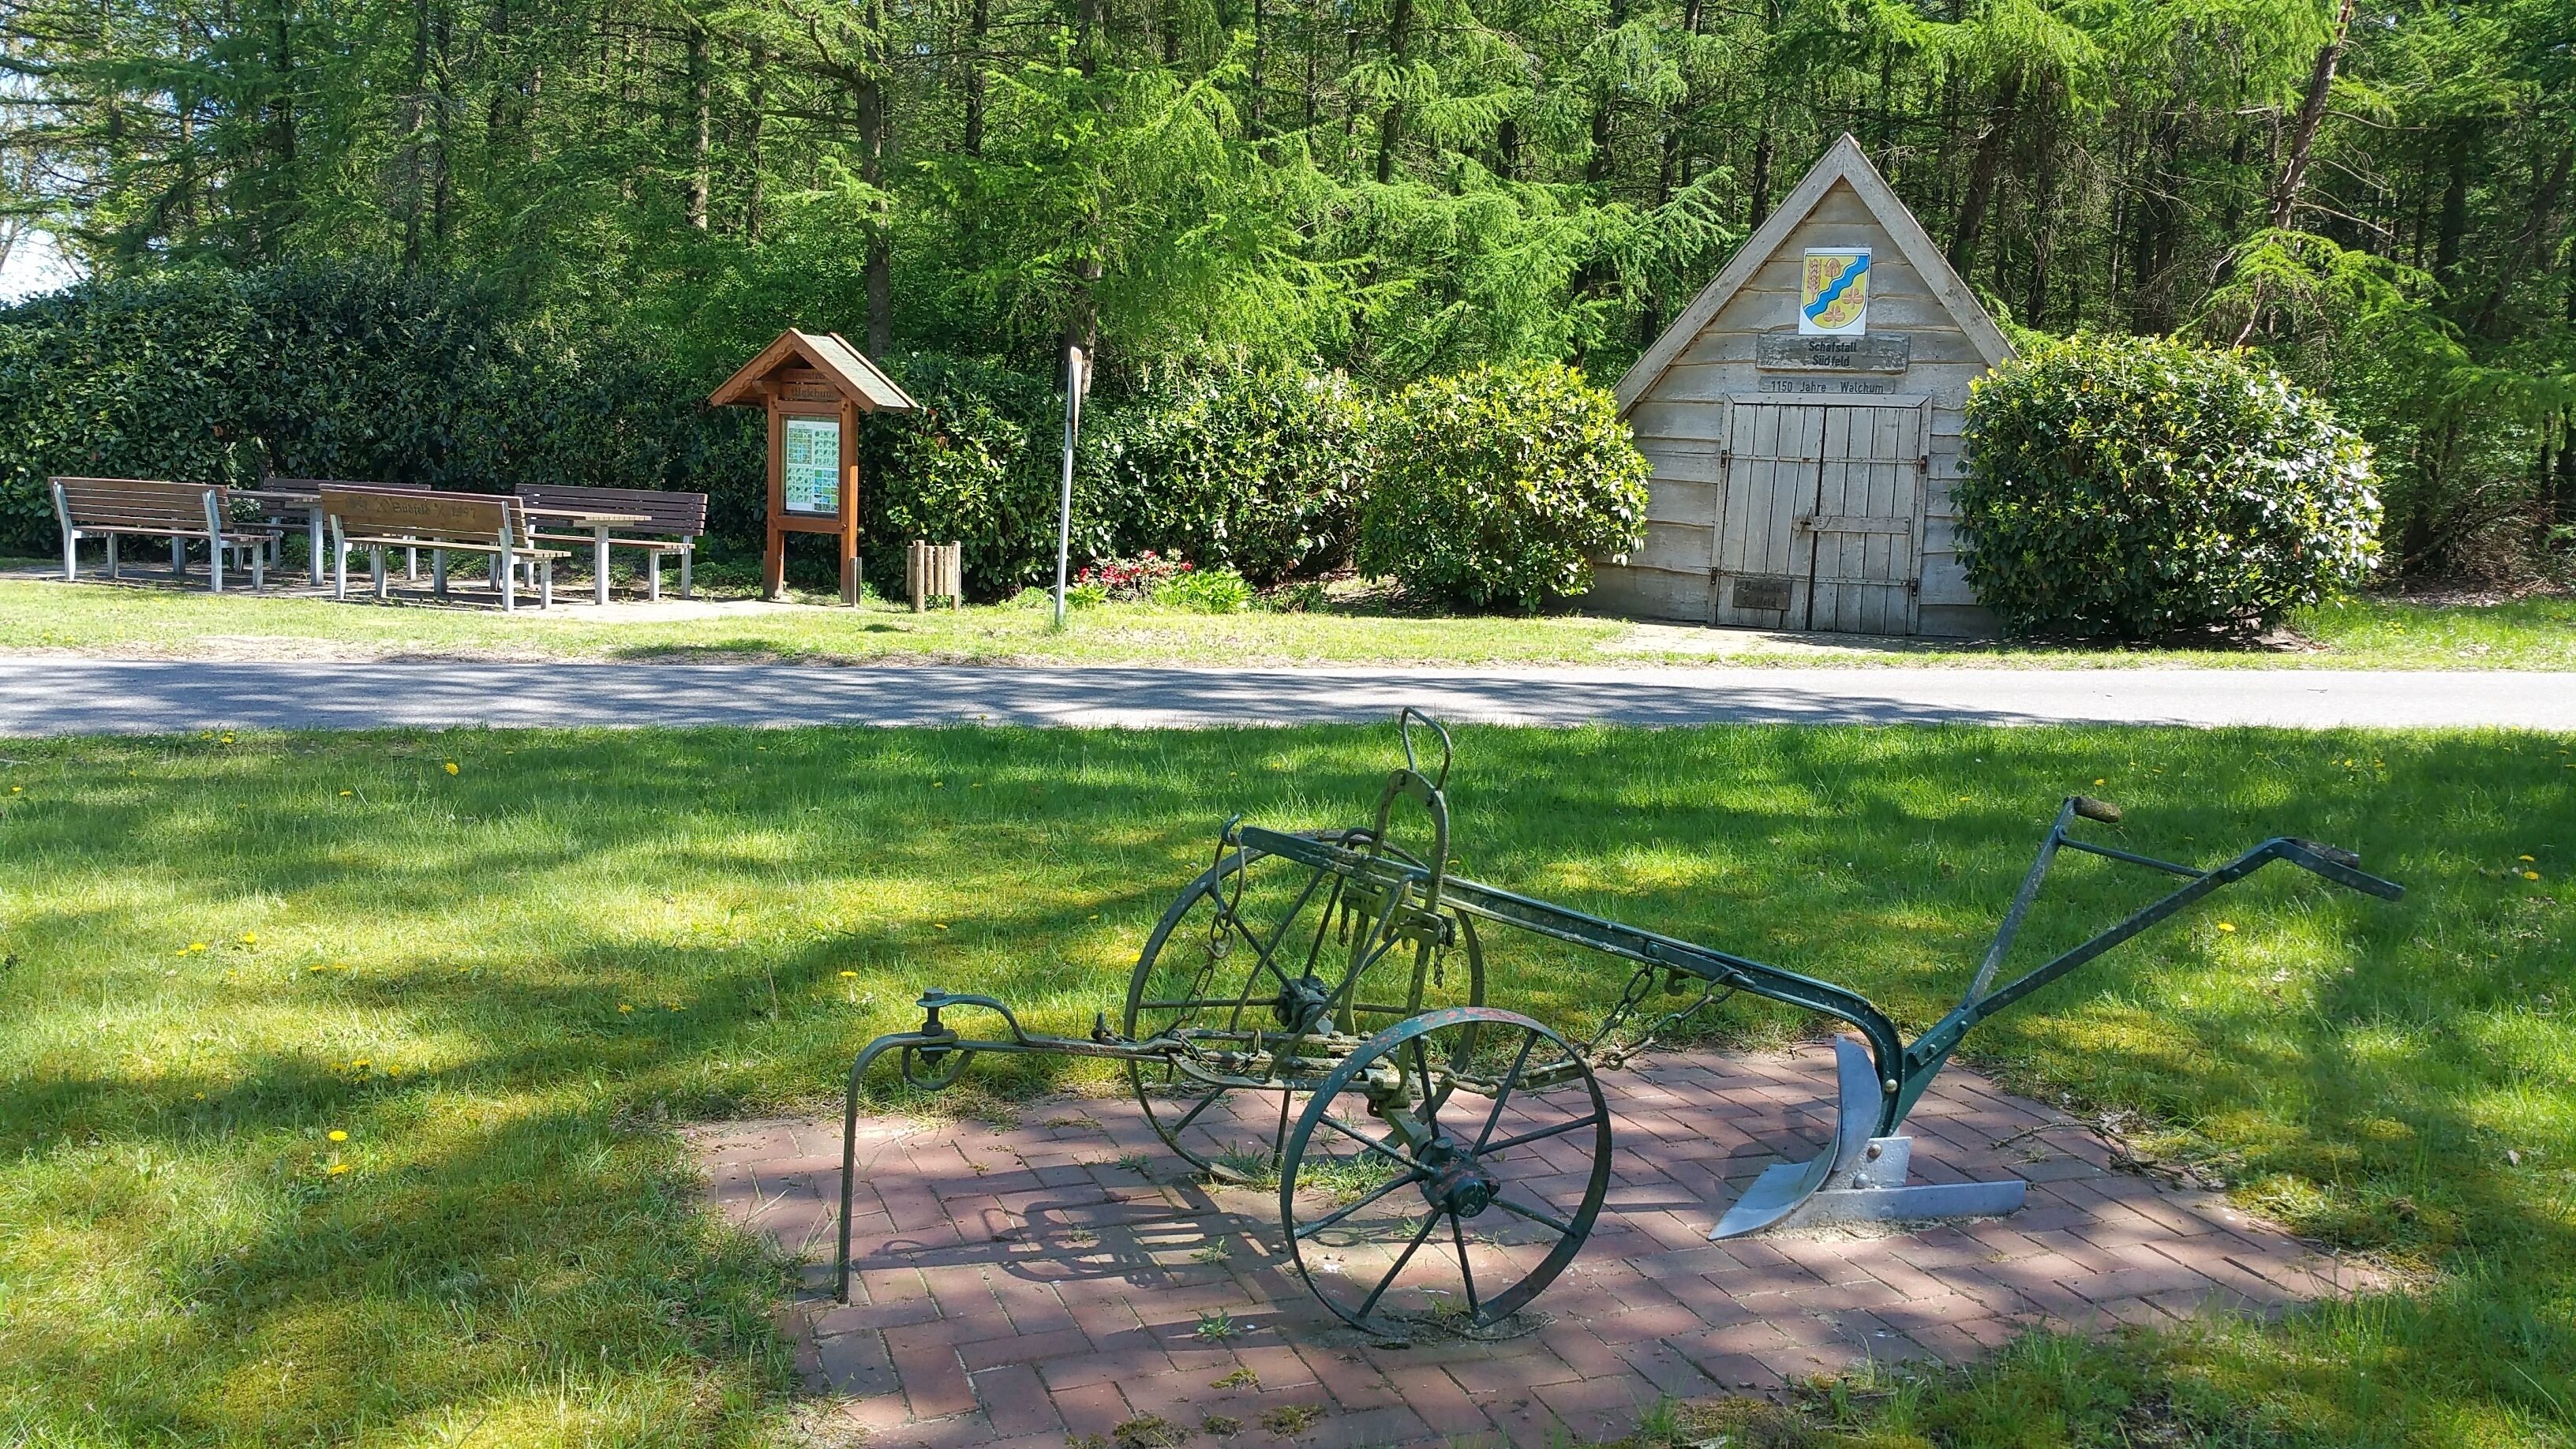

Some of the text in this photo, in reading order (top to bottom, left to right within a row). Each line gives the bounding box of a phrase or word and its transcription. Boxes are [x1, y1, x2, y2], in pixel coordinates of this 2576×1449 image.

[1808, 340, 1856, 353] Schafstall
[1812, 354, 1850, 367] Südfeld
[1771, 380, 1884, 394] 1150 Jahre Walchum
